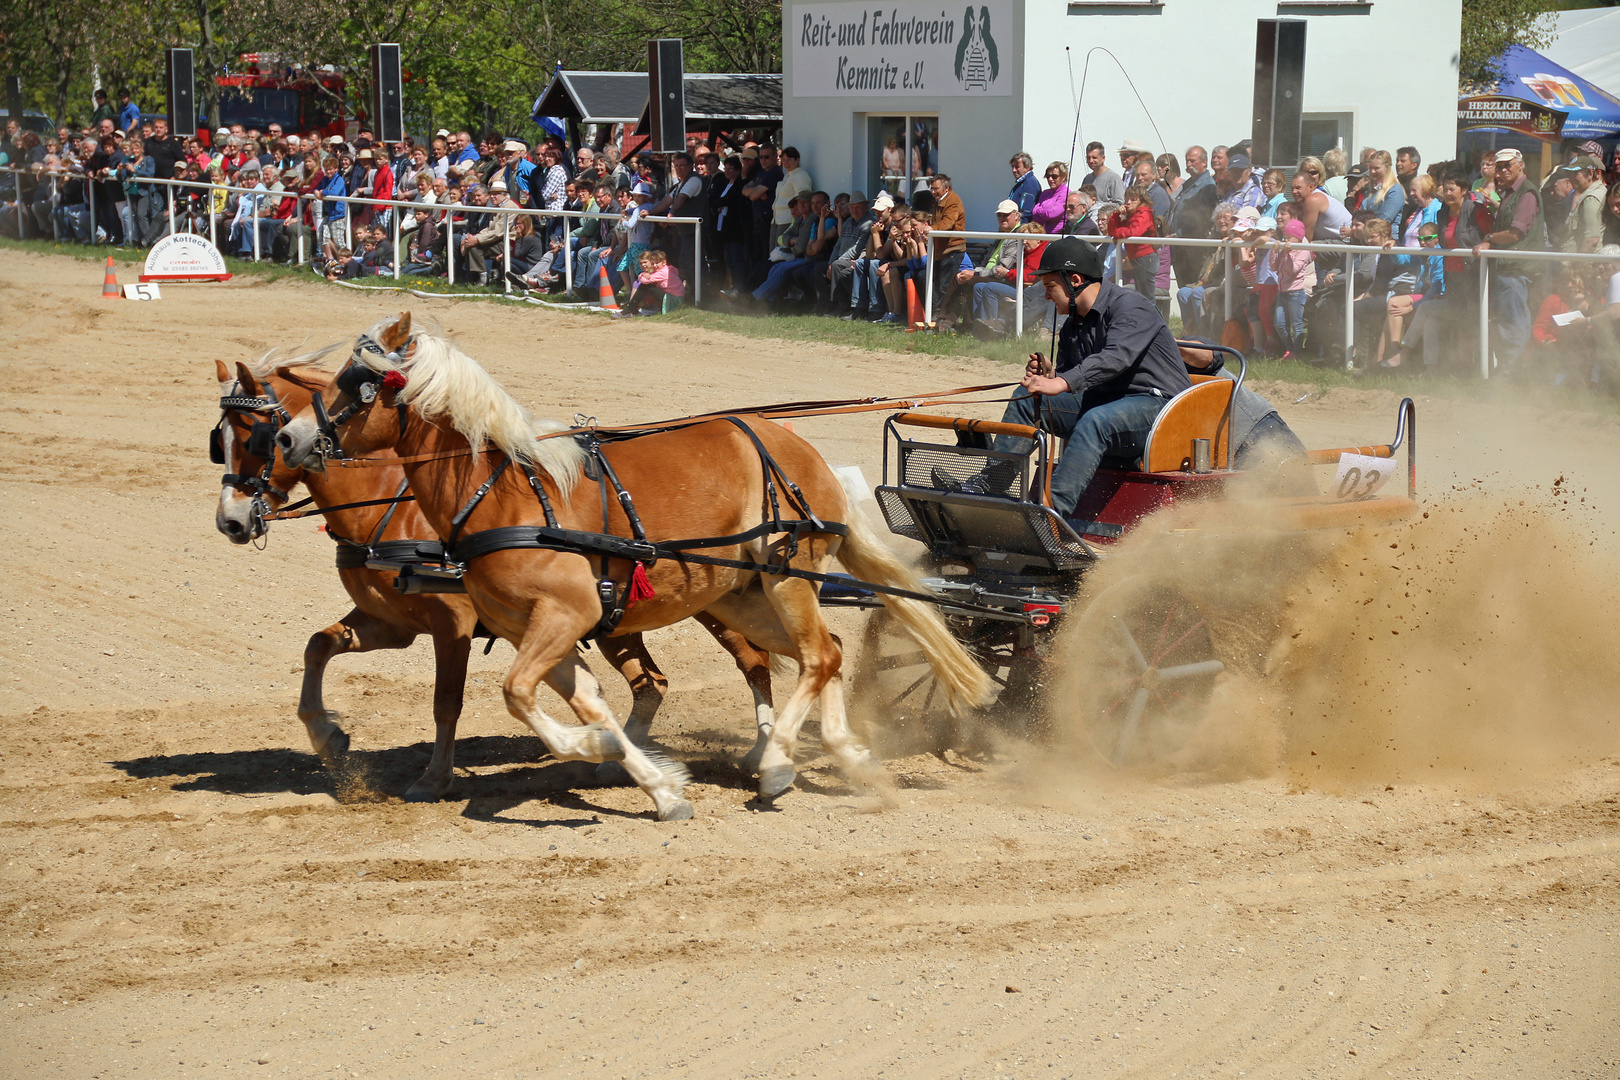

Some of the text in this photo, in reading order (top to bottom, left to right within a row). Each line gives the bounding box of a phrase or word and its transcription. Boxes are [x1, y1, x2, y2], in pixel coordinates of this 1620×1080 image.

[801, 9, 954, 47] Reit-und Fahrverein
[836, 55, 924, 90] Kemnitz e.V.
[1457, 111, 1531, 119] WILLKOMMEN!
[1468, 101, 1521, 110] HERZLICH
[148, 237, 221, 271] Autohaus Kotteck Löbau
[135, 284, 152, 301] 5
[1337, 467, 1380, 498] 03
